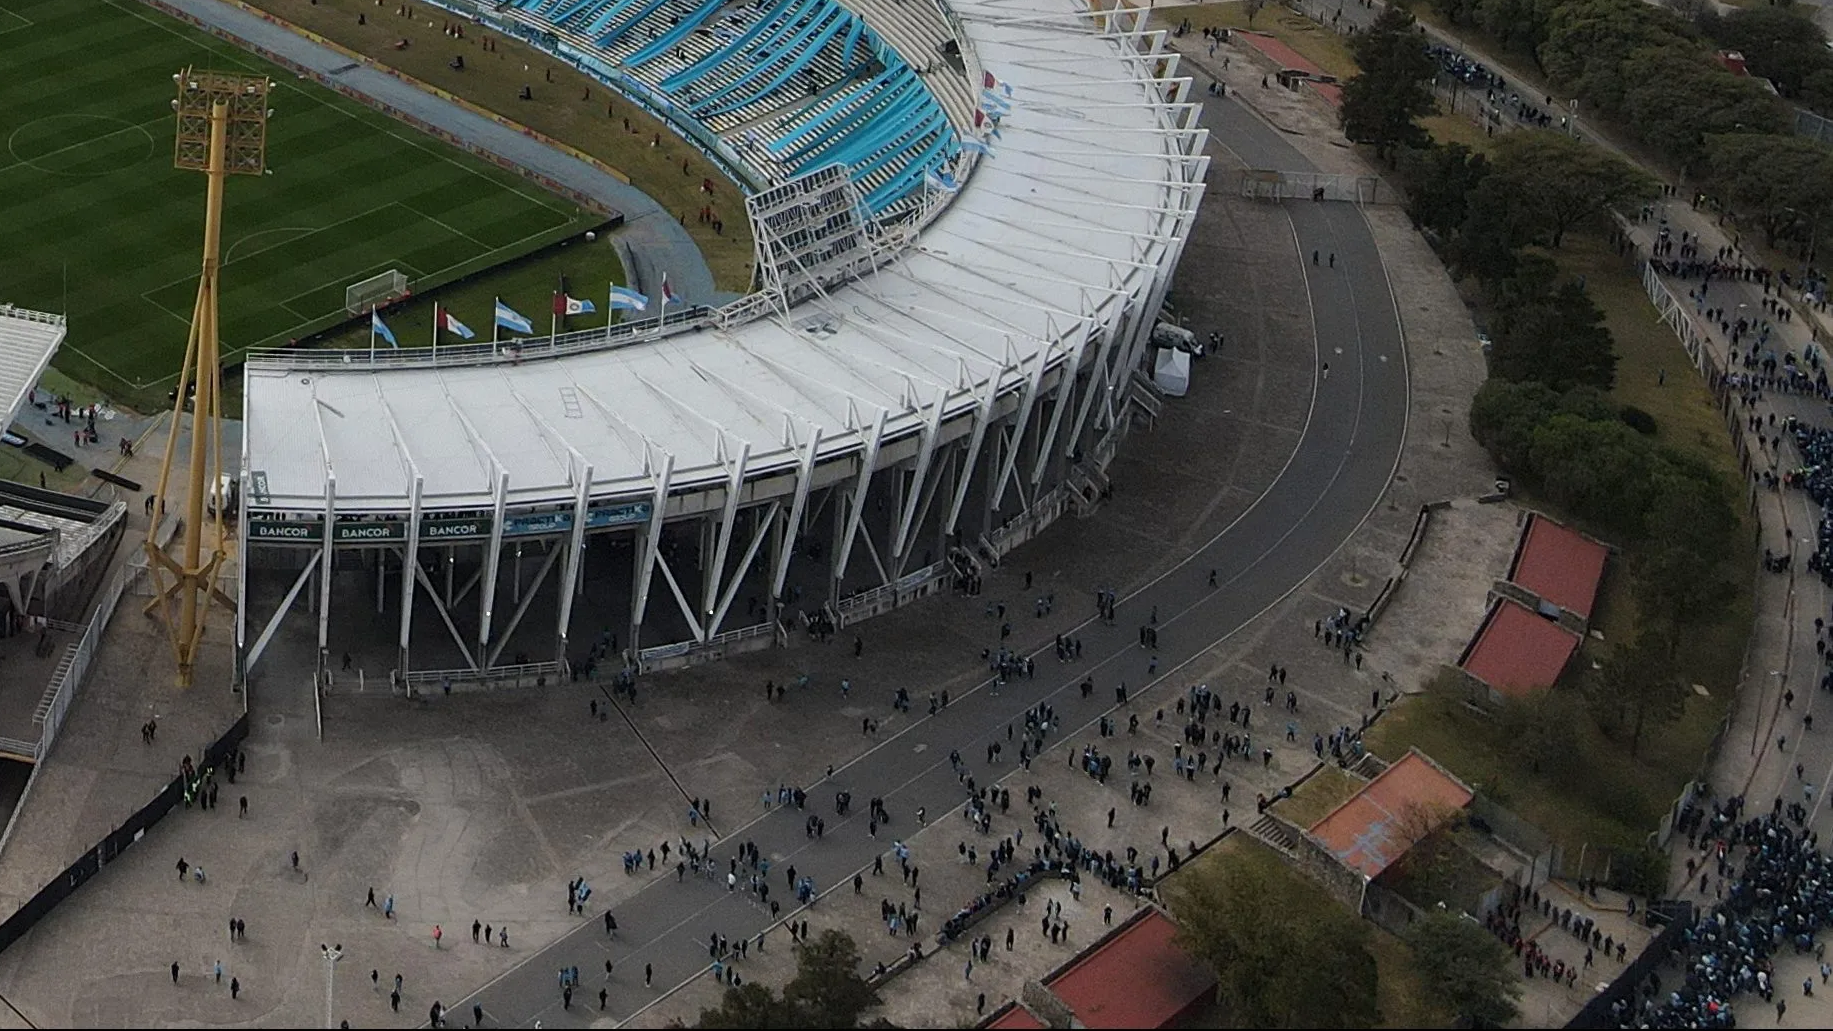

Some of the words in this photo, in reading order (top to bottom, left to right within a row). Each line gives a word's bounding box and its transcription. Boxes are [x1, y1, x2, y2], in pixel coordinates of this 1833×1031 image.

[259, 526, 309, 538] BANCOR
[341, 527, 391, 538] BANCOR
[429, 524, 477, 535] BANCOR
